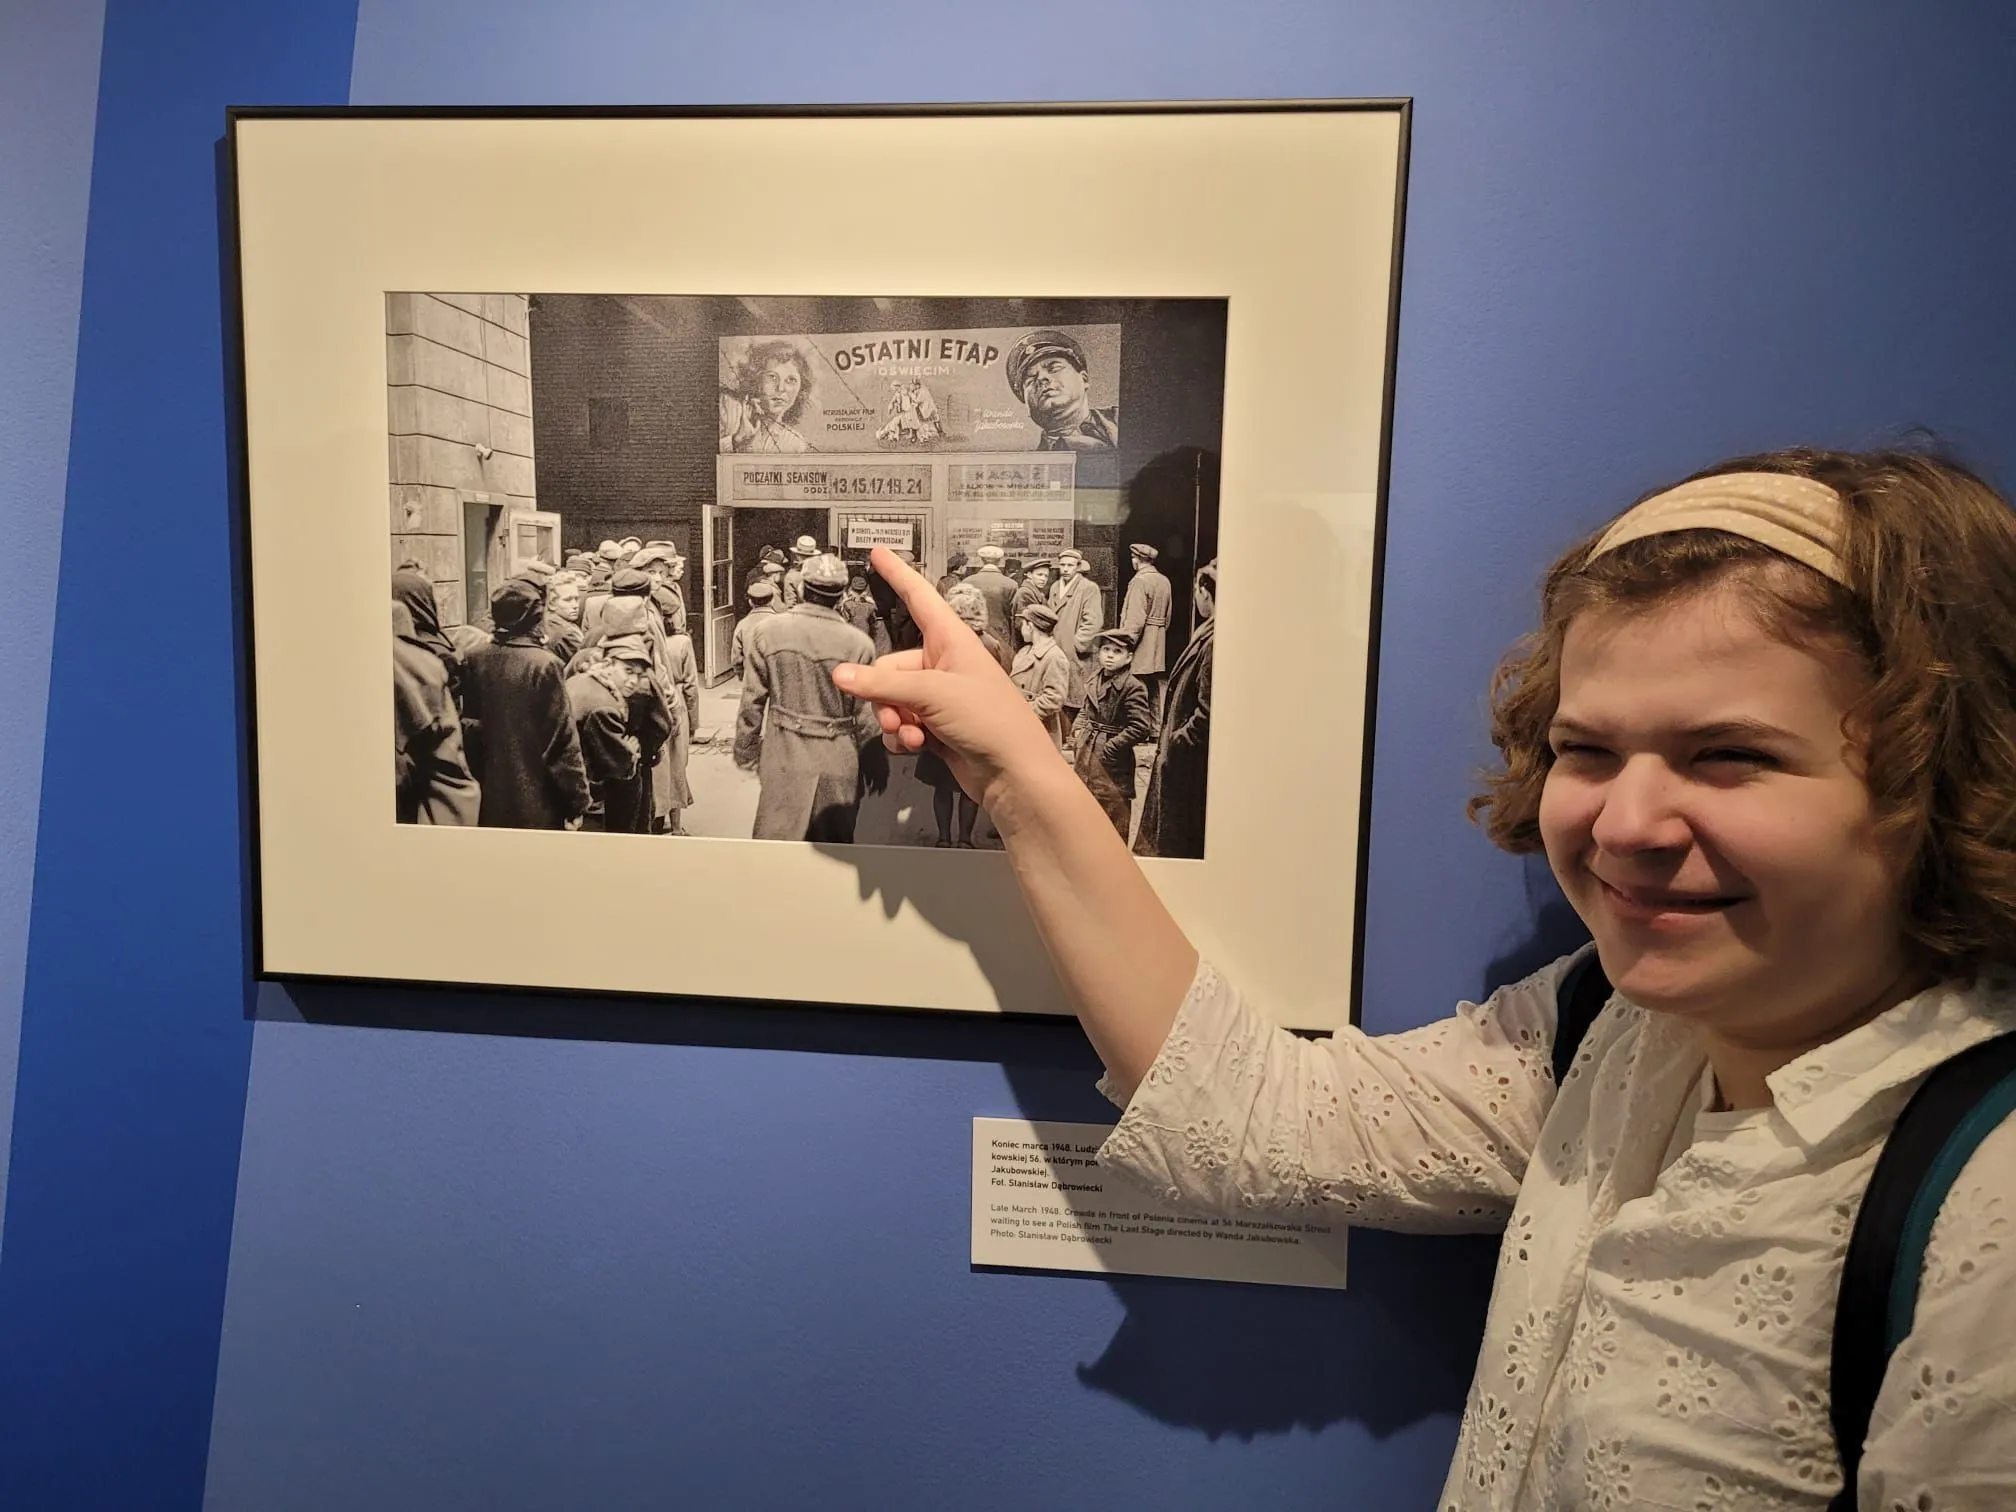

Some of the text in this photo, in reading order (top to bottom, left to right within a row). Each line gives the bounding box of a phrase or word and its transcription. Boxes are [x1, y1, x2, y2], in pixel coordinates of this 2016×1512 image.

[834, 338, 1000, 371] OSTATNI ETAP
[826, 423, 865, 431] POLSKIEJ
[743, 471, 783, 486] POCZĄTKI
[991, 1139, 1020, 1149] Koniec
[1022, 1143, 1049, 1151] marca
[1051, 1143, 1073, 1152] 1948.
[991, 1153, 1028, 1164] kowskiej
[1052, 1156, 1083, 1167] którym
[991, 1165, 1050, 1178] Jakubowskiej.
[991, 1177, 1103, 1193] Fot. Stanisław Dąbrowiecki
[990, 1204, 1009, 1212] Late
[1011, 1205, 1038, 1214] March
[1040, 1207, 1062, 1215] 1948.
[1064, 1208, 1096, 1218] Crowds
[1098, 1211, 1107, 1219] in
[1109, 1211, 1130, 1220] front
[1132, 1211, 1141, 1220] of
[1143, 1213, 1175, 1223] Polonia
[1177, 1217, 1208, 1226] cinema
[1222, 1219, 1233, 1227] 56
[1304, 1223, 1331, 1234] Street
[990, 1217, 1020, 1227] waiting
[1022, 1218, 1030, 1226] to
[1056, 1220, 1082, 1229] Polish
[1083, 1222, 1100, 1231] film
[1103, 1223, 1118, 1232] The
[1120, 1224, 1140, 1233] Last
[1141, 1225, 1165, 1236] Stage
[1167, 1228, 1201, 1238] directed
[1203, 1230, 1213, 1239] by
[1215, 1231, 1245, 1241] Wanda
[1018, 1231, 1059, 1241] Stanisław
[1060, 1233, 1112, 1245] Dąbrowiecki
